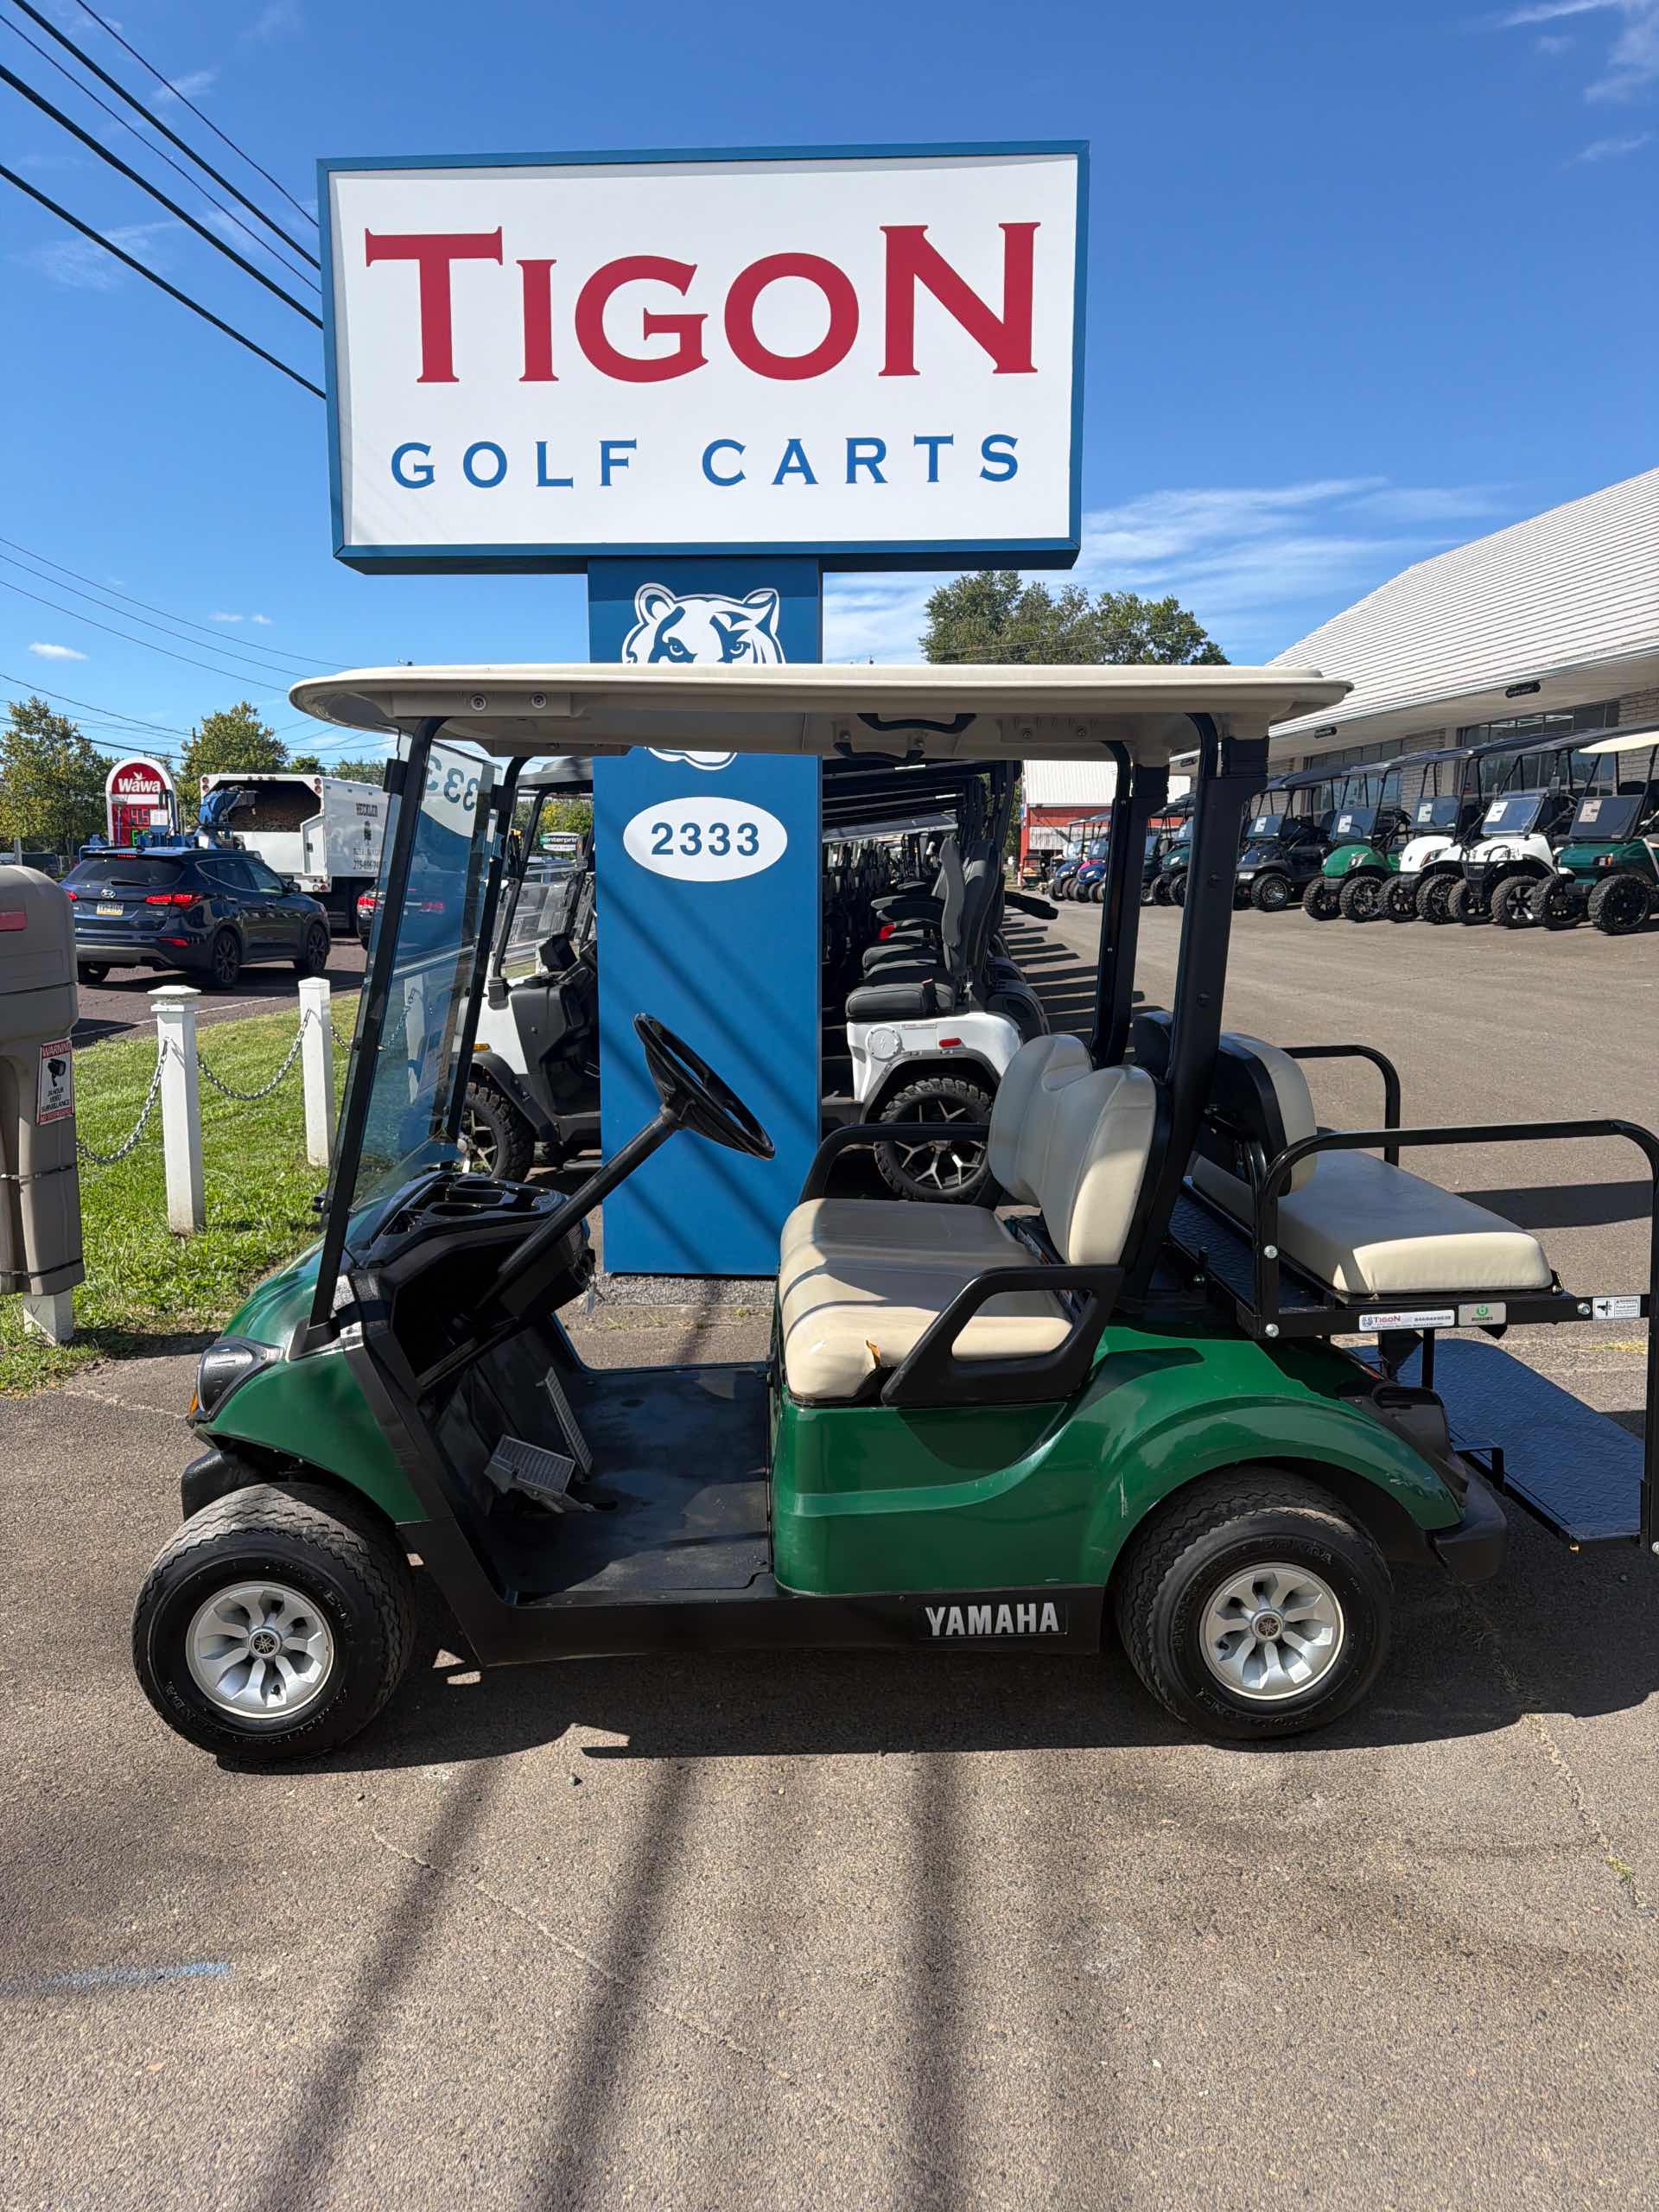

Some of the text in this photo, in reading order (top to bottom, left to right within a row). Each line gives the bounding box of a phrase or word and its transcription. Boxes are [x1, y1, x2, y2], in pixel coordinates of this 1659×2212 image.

[365, 222, 1041, 384] TIGON
[391, 433, 1019, 490] GOLF CARTS
[118, 777, 162, 793] Wawa
[651, 822, 760, 857] 2333
[42, 1040, 71, 1058] WARNING
[925, 1602, 1059, 1637] YAMAHA
